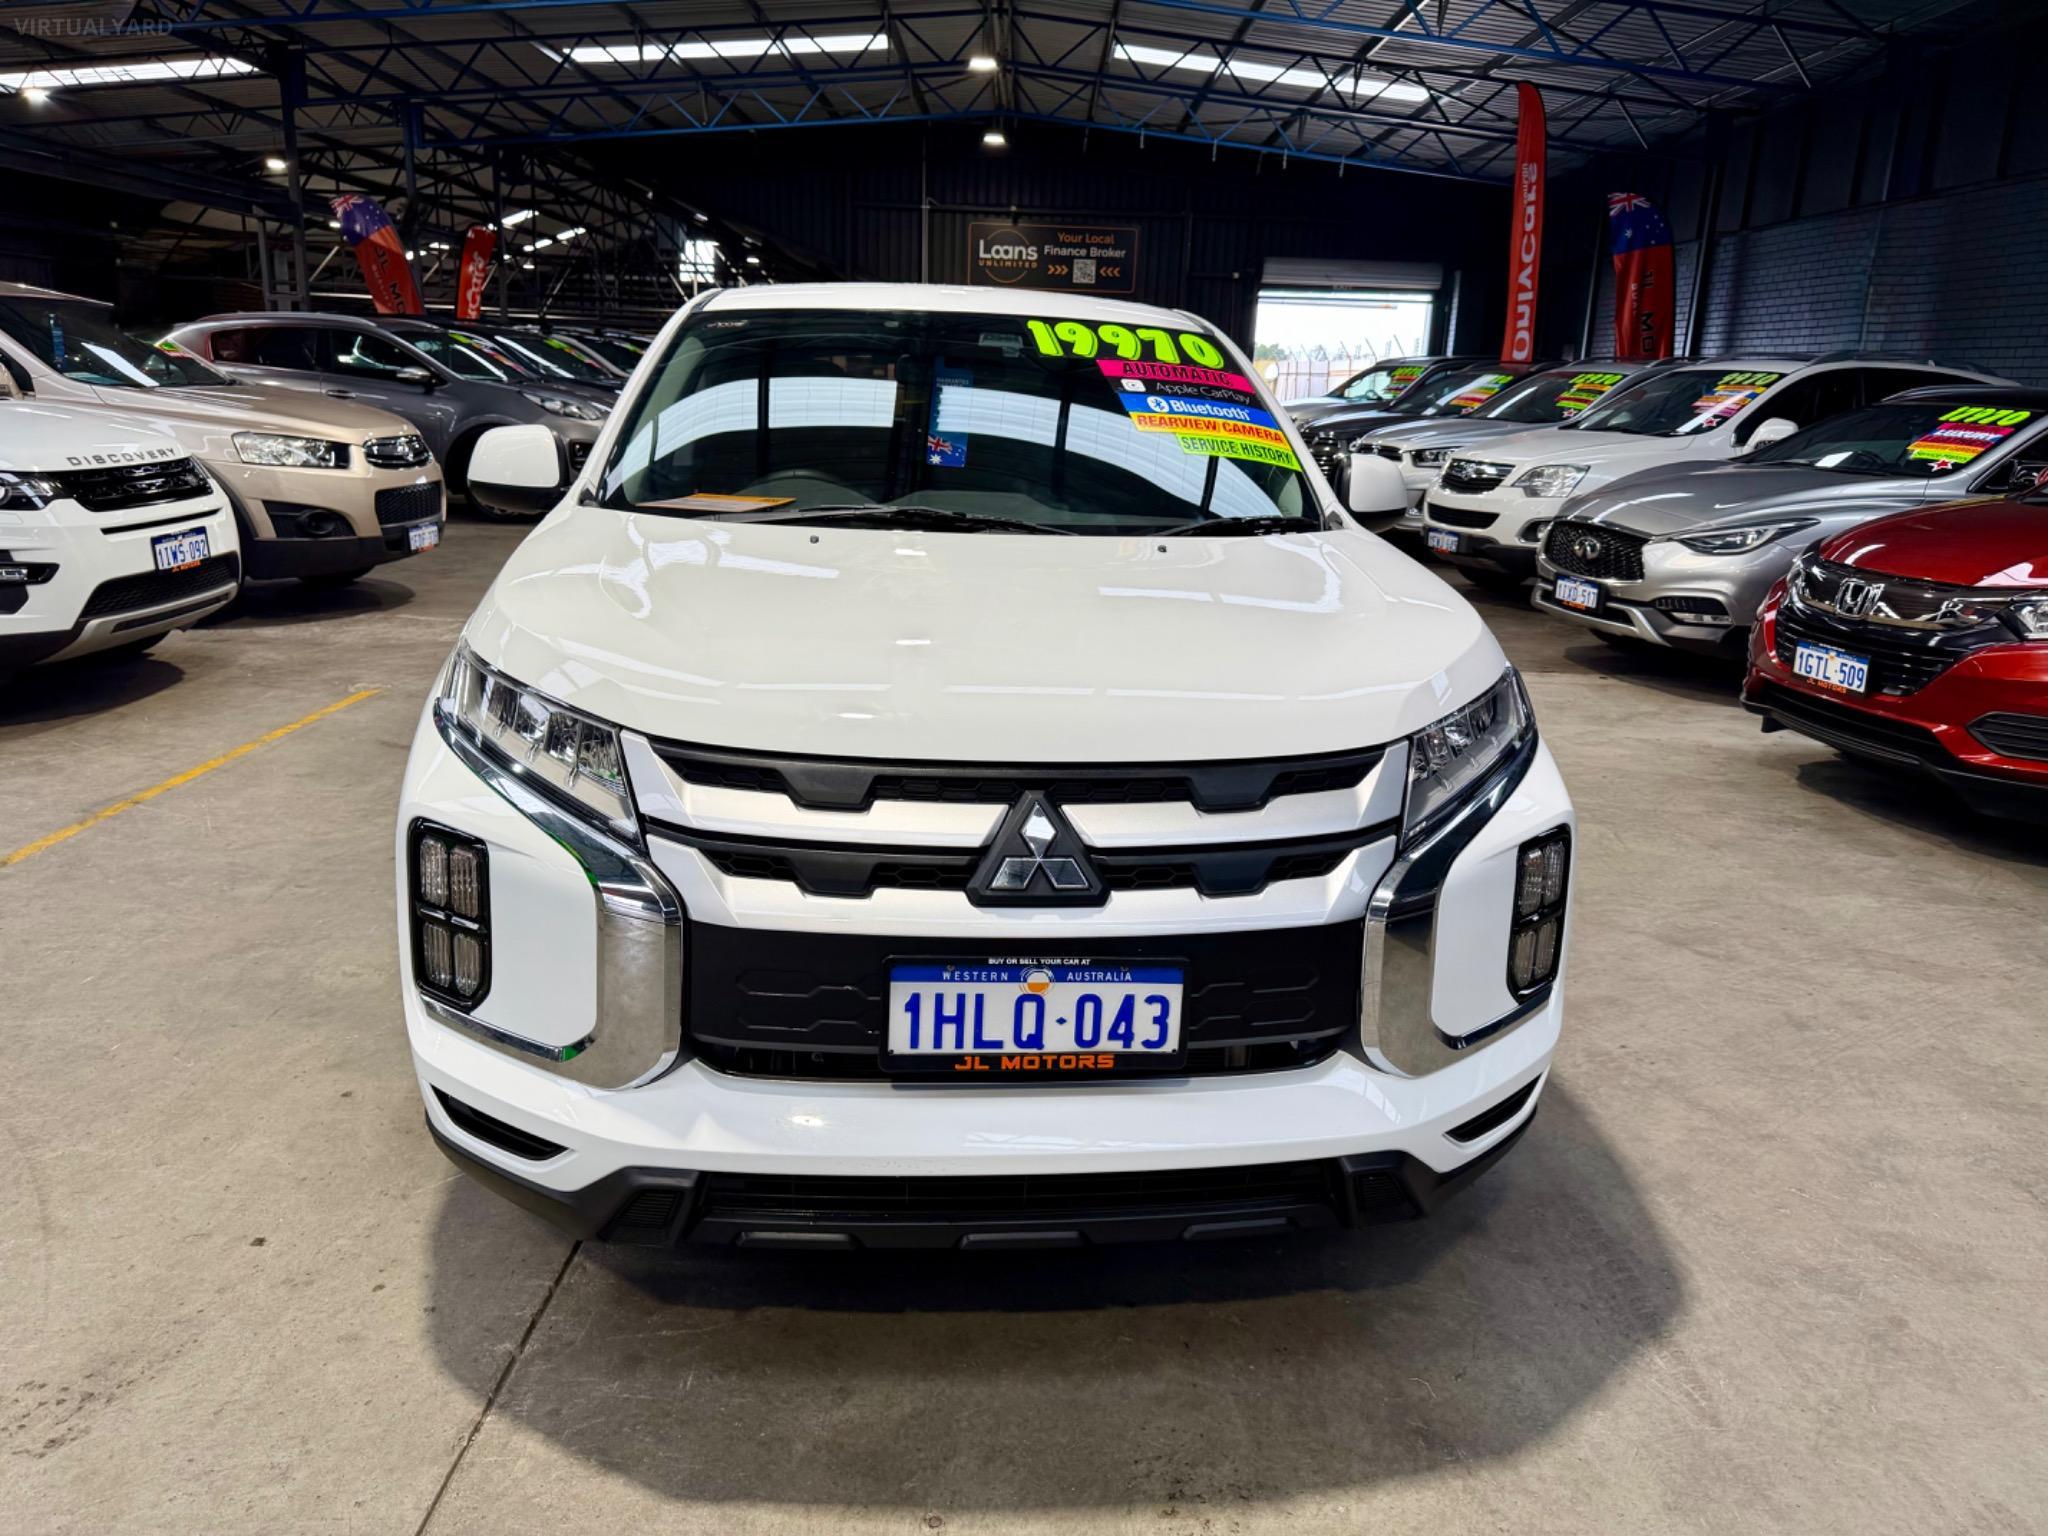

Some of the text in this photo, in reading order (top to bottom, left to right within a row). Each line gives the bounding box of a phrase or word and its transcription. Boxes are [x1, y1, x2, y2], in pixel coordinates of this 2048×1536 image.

[1057, 232, 1115, 244] Your Local
[978, 239, 1038, 261] Loans
[1043, 244, 1126, 258] Finance Broker
[978, 260, 1039, 269] UNLIMITED
[1027, 320, 1225, 369] 19970
[1122, 362, 1232, 386] AUTOMATIC
[1155, 382, 1250, 405] Apple CarPlay
[1137, 414, 1283, 444] REARVIEW CAMERA
[65, 447, 176, 466] DISCOVERY
[1182, 435, 1292, 465] SERVICE HISTORY
[943, 972, 1133, 981] WESTERN AUSTRALIA
[955, 1054, 1115, 1070] JL MOTORS
